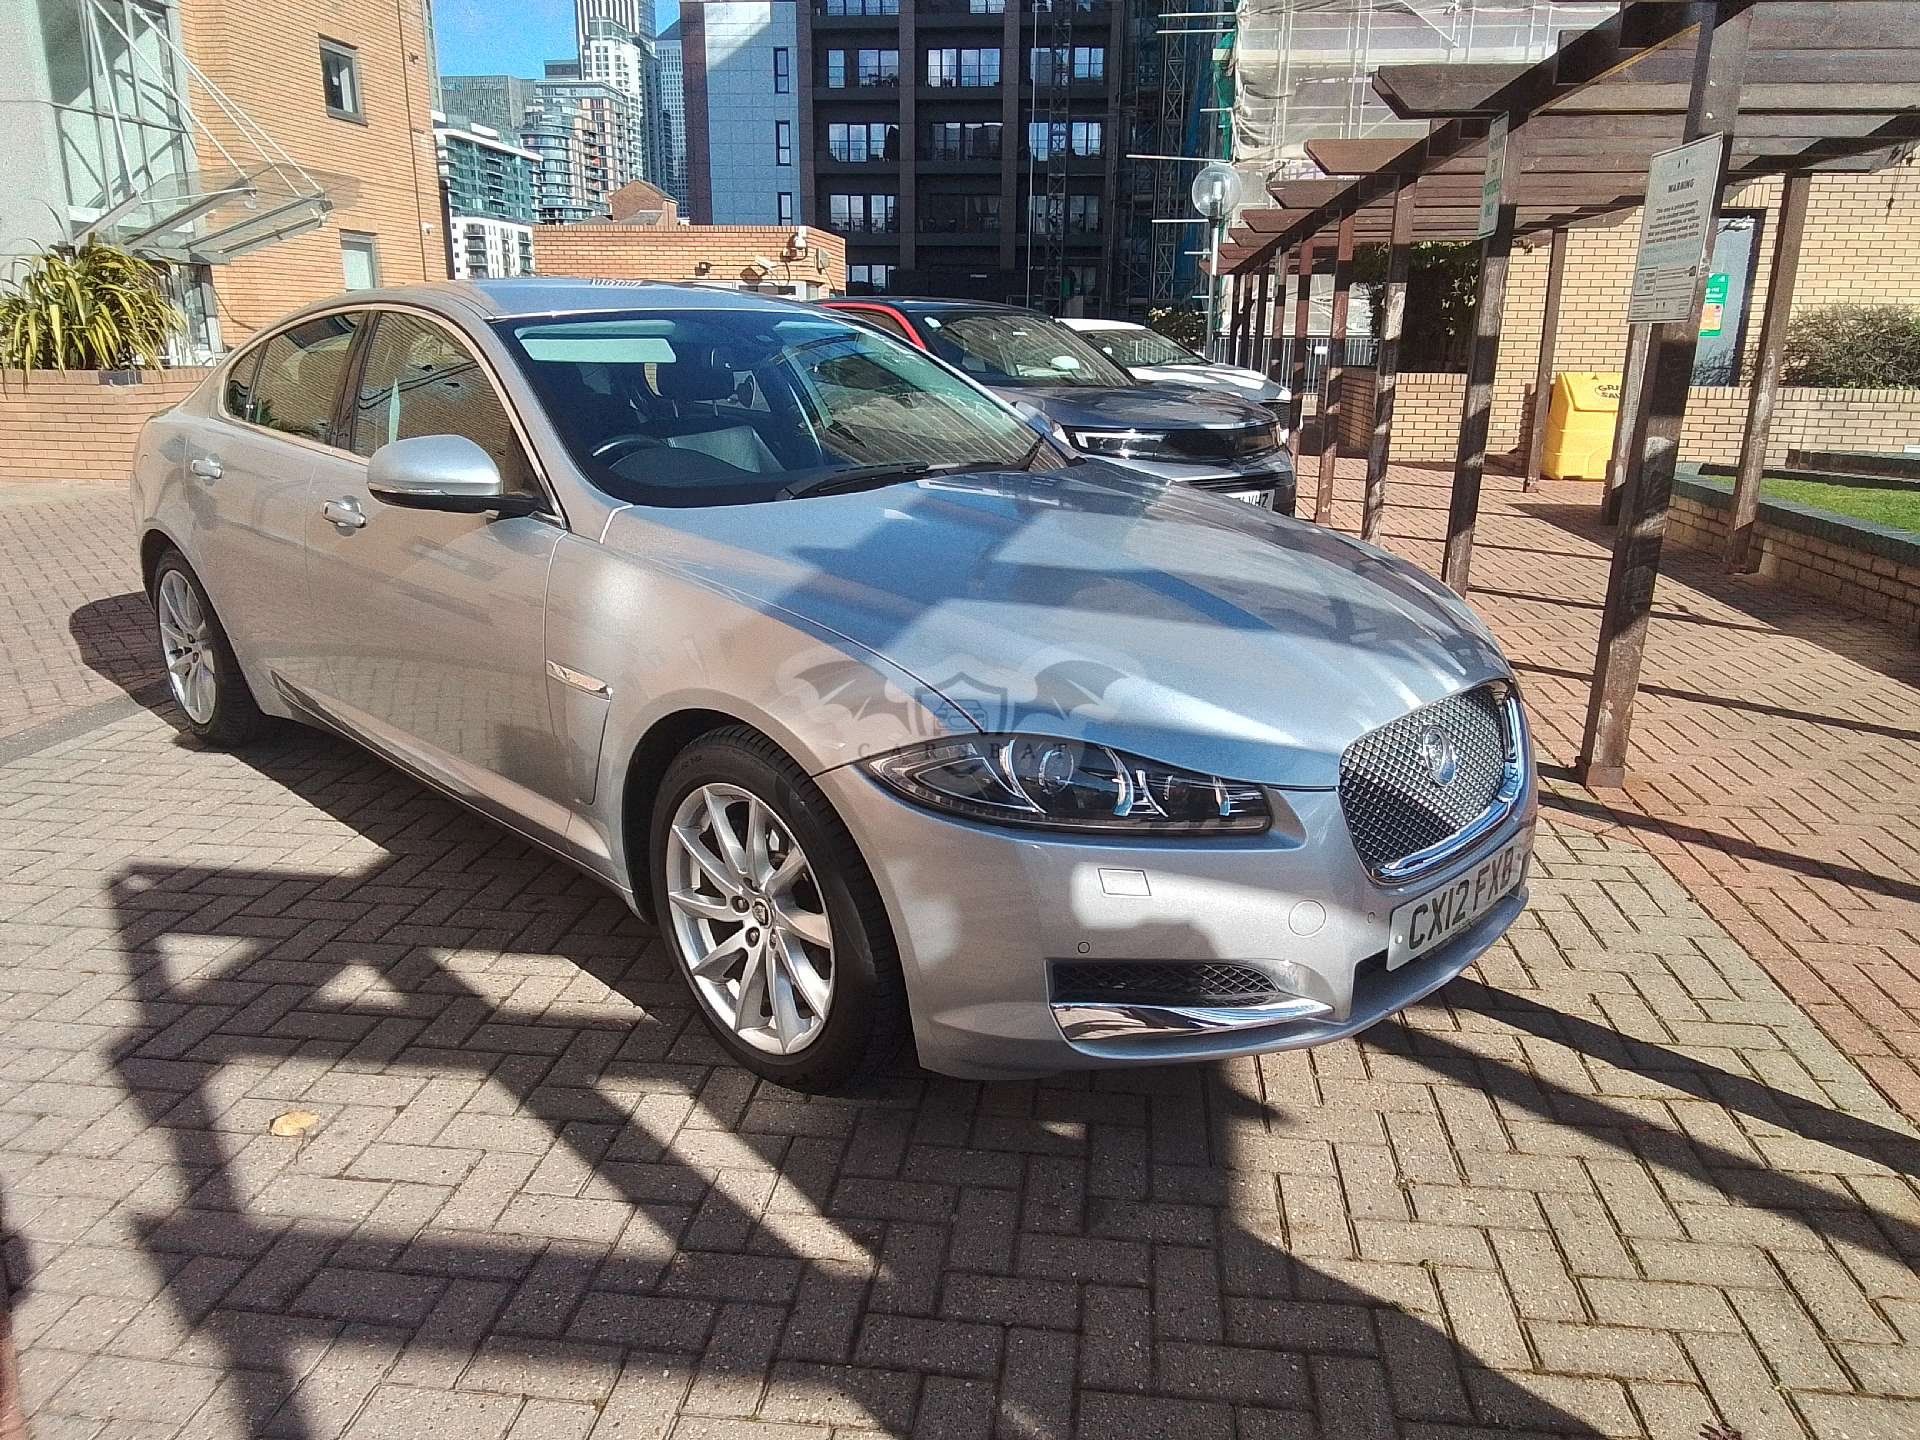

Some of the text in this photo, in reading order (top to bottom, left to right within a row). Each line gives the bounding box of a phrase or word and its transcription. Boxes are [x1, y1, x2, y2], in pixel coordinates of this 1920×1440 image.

[1667, 177, 1695, 193] WARNING
[1408, 845, 1514, 950] CX12 FXB
